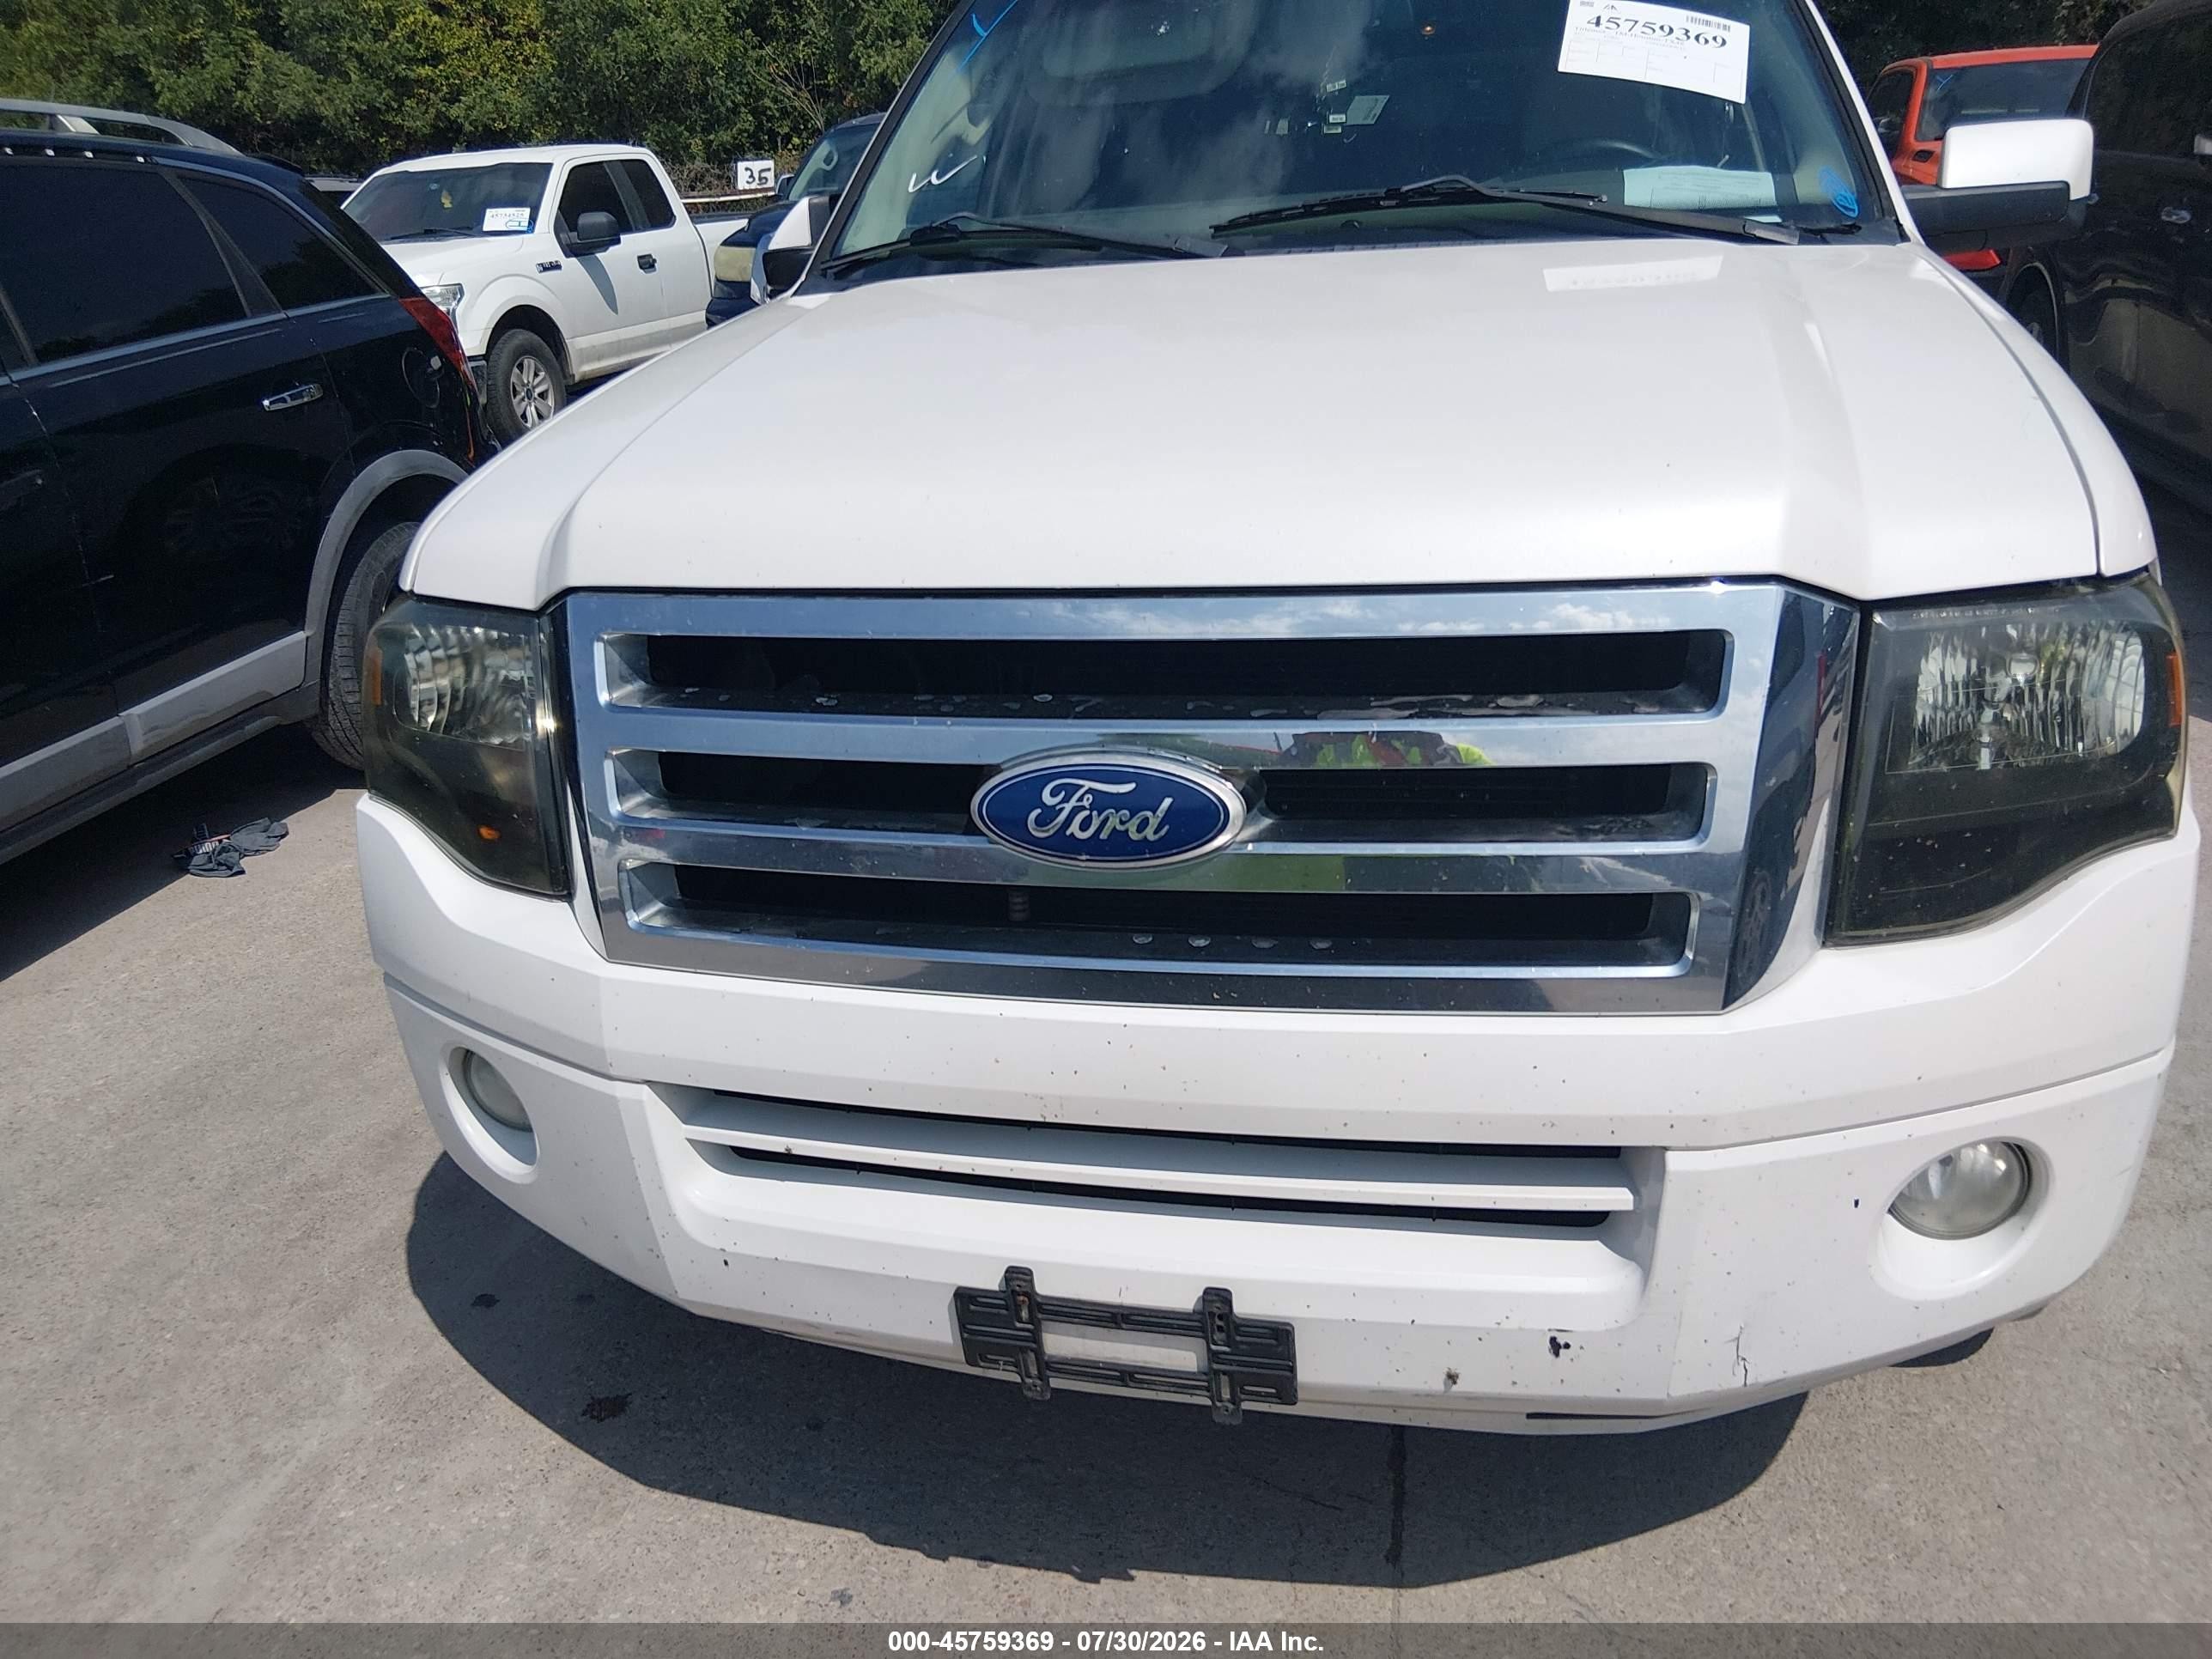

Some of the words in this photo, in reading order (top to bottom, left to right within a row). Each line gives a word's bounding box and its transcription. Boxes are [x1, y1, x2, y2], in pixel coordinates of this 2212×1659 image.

[1586, 15, 1728, 49] 45759369
[744, 167, 771, 185] 35
[1028, 778, 1174, 842] Ford
